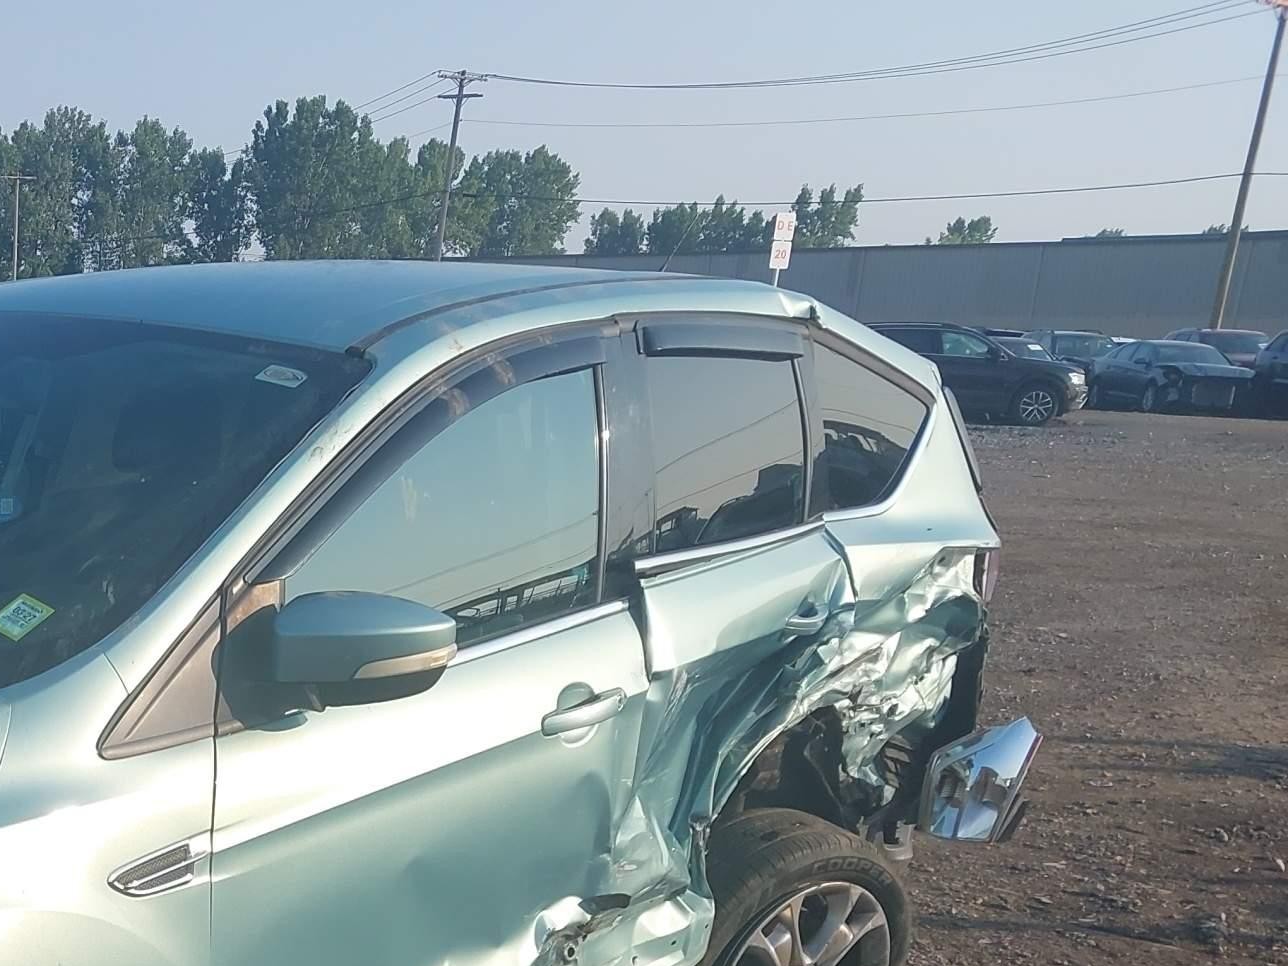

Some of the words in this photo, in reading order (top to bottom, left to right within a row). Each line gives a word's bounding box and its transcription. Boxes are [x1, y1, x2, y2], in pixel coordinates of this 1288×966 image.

[777, 220, 785, 231] D
[787, 221, 794, 231] E
[774, 249, 787, 260] 20
